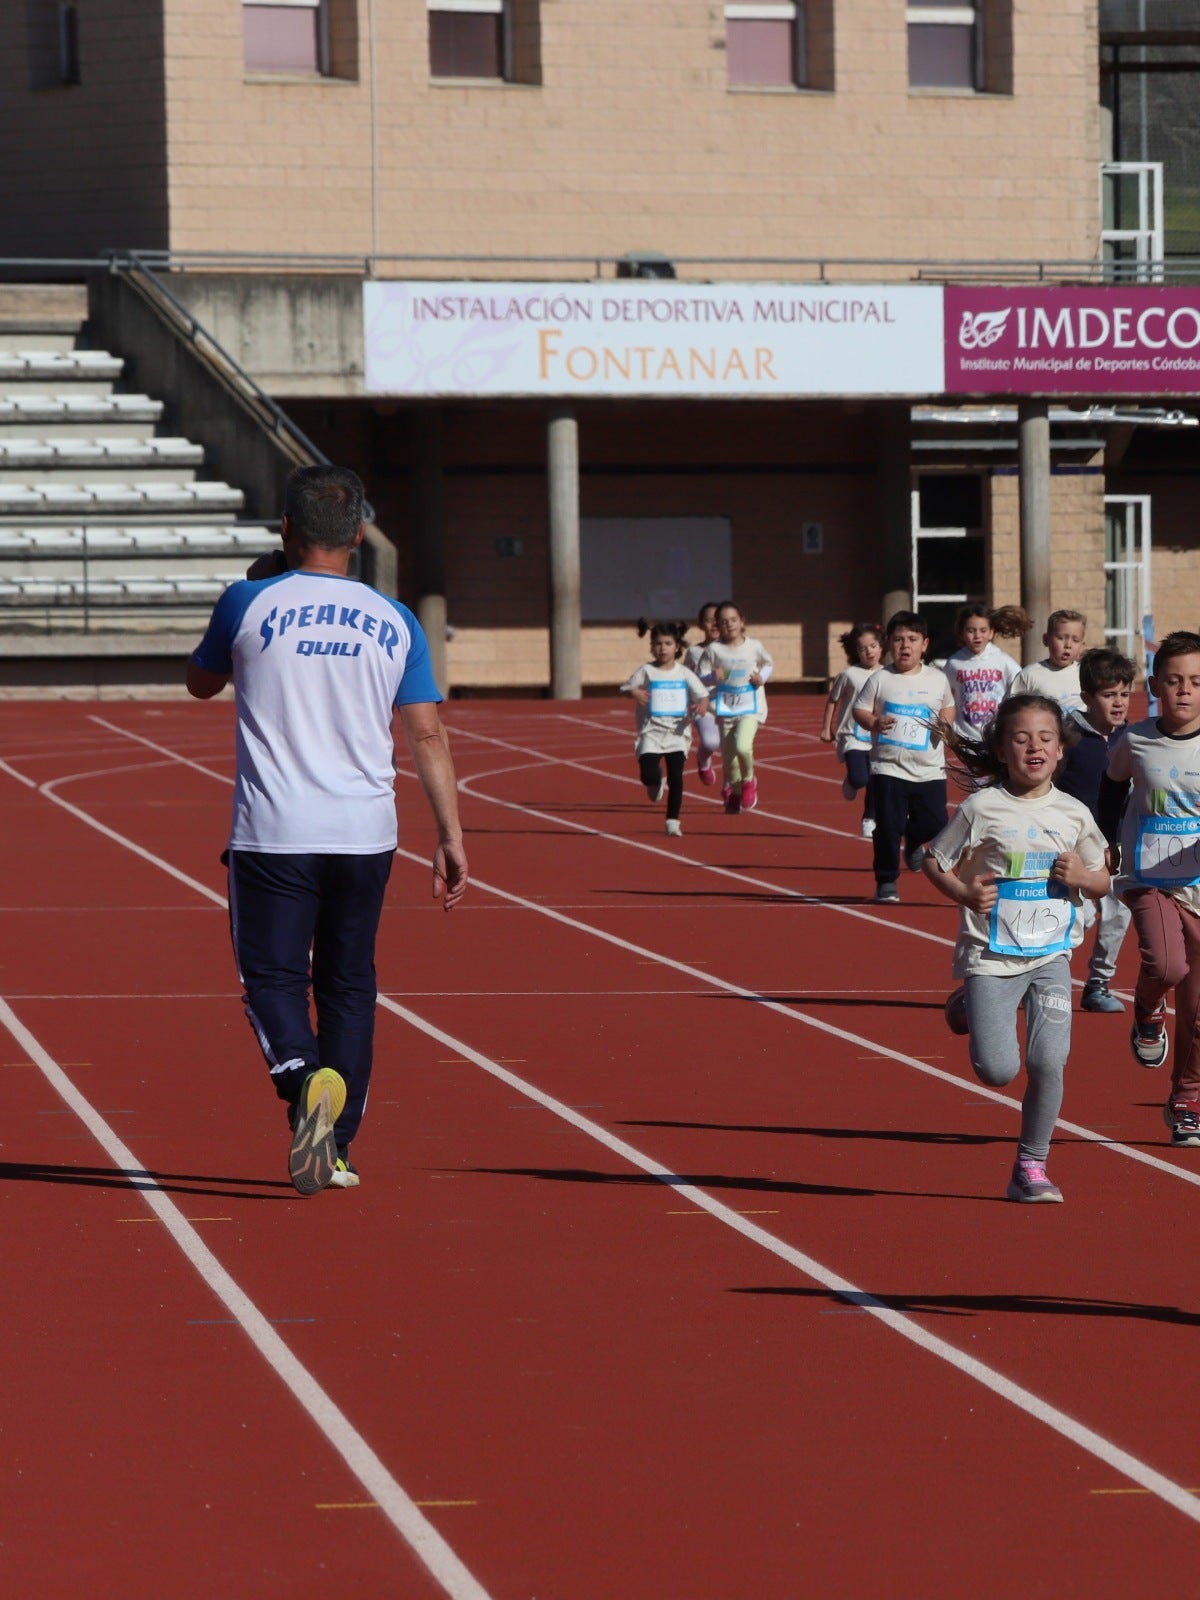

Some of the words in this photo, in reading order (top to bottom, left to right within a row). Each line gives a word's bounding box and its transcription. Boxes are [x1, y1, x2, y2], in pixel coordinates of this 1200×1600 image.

[412, 294, 593, 321] INSTALACIÓN
[602, 300, 745, 323] DEPORTIVA
[752, 300, 896, 323] MUNICIPAL
[960, 357, 1011, 371] Instituto
[1014, 357, 1073, 373] Municipal
[1075, 357, 1091, 371] de
[1094, 357, 1150, 373] Deportes
[259, 603, 400, 662] SPEAKER
[296, 640, 362, 657] QUILI
[956, 669, 1002, 684] ALWAYS
[964, 680, 994, 693] HAVE
[1154, 820, 1187, 832] unicef
[1010, 908, 1060, 938] 113
